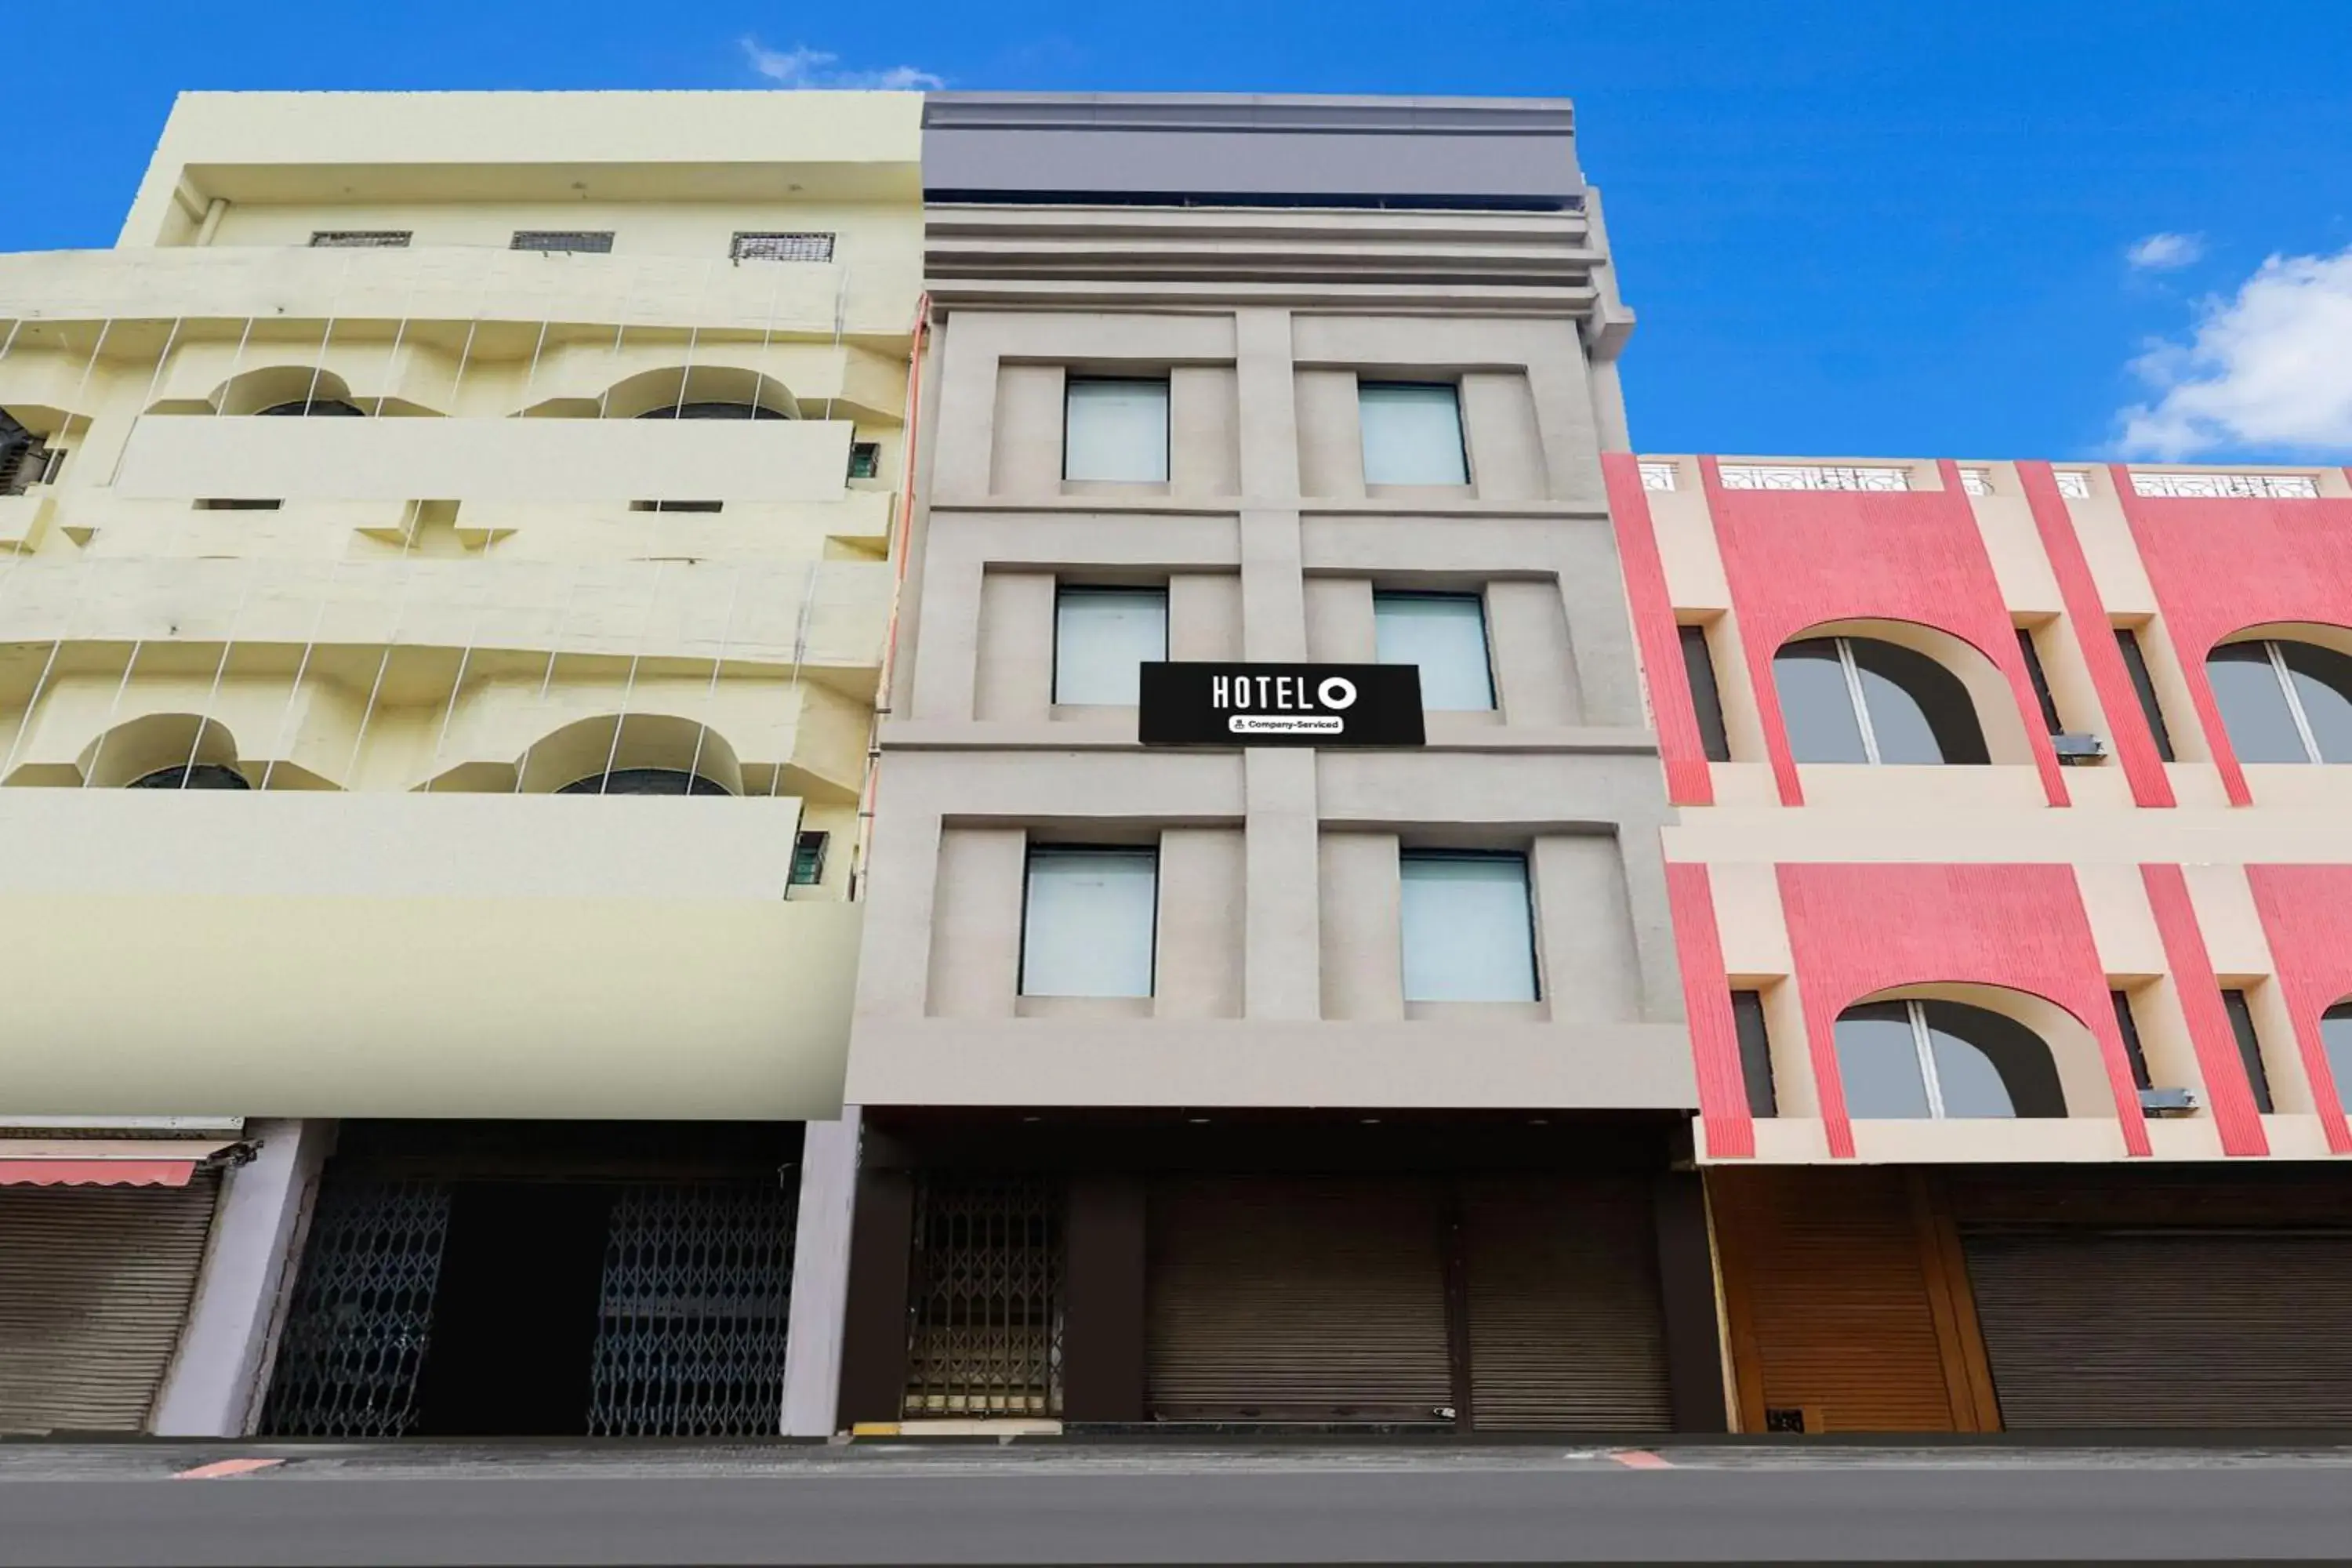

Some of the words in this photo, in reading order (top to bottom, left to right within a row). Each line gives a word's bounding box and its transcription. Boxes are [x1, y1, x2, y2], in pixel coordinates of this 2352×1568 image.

[1213, 676, 1314, 709] HOTEL
[1318, 677, 1357, 710] O
[1248, 720, 1339, 730] Company-Serviced
